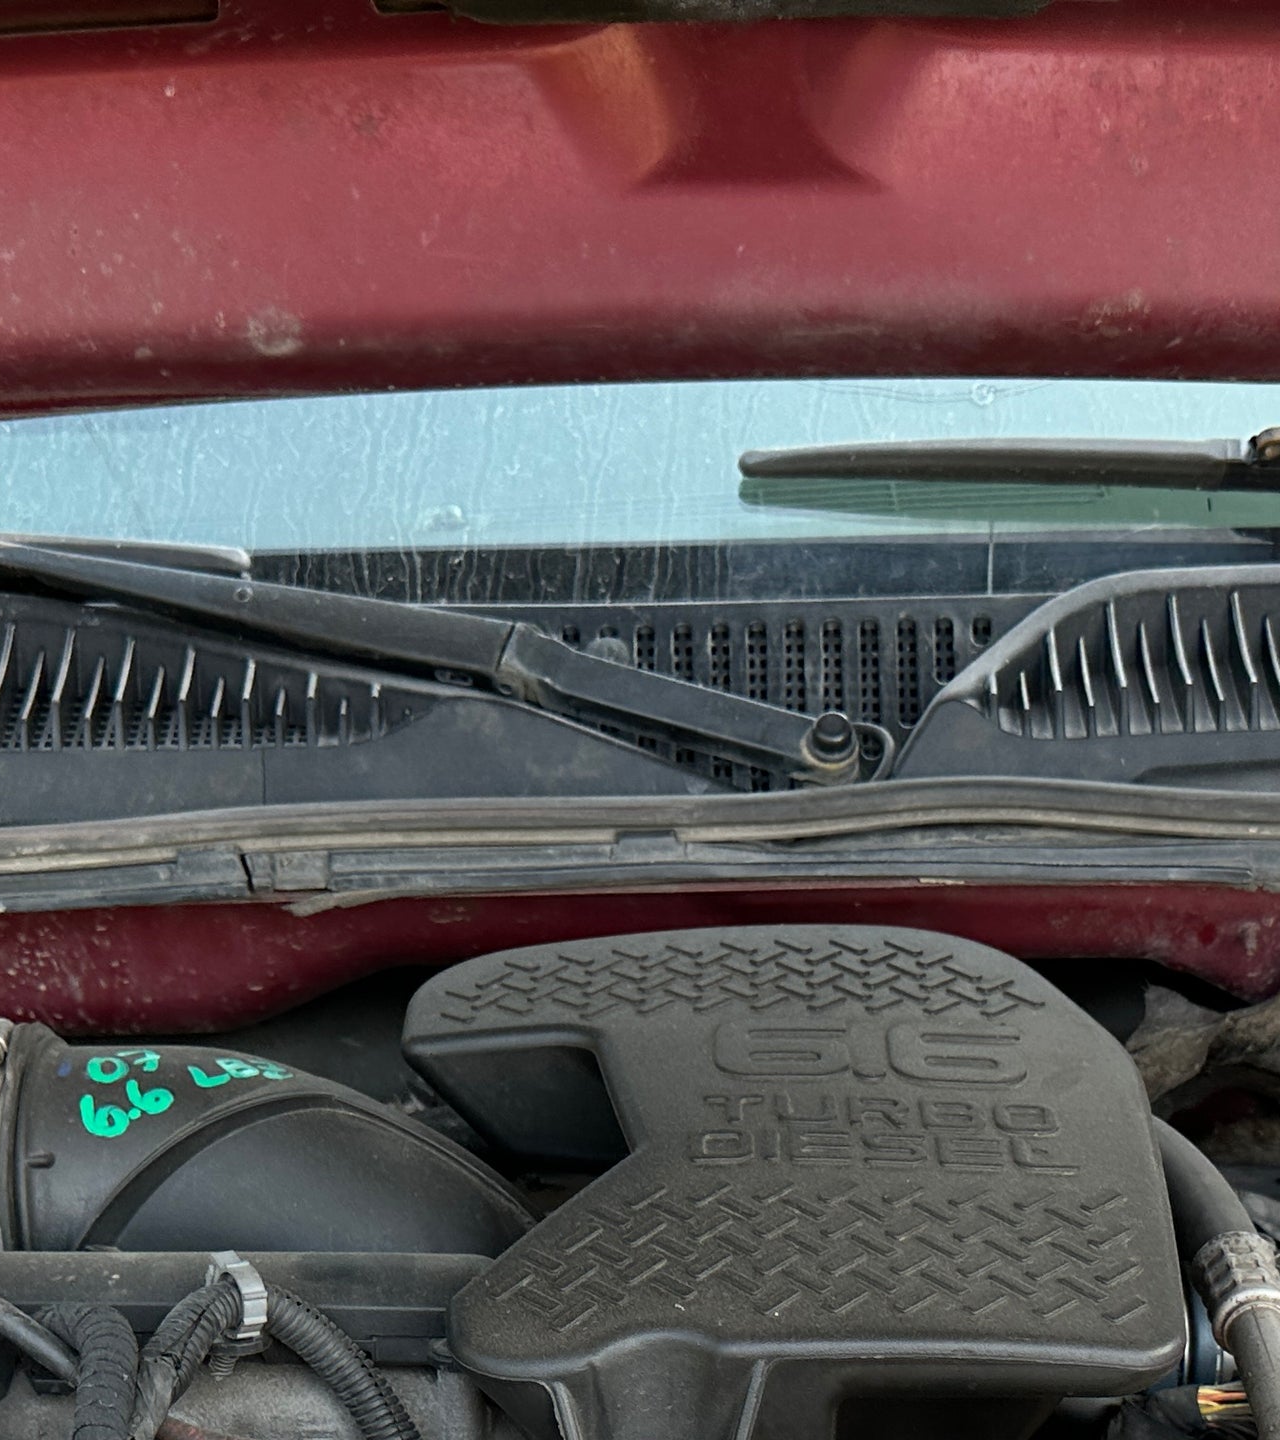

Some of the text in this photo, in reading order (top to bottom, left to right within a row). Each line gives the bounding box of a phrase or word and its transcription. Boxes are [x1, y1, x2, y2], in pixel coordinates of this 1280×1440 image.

[712, 1018, 1027, 1087] 6.6
[79, 1079, 174, 1138] 6.6
[702, 1094, 1060, 1137] TURBO
[690, 1131, 1082, 1176] DIESEL
